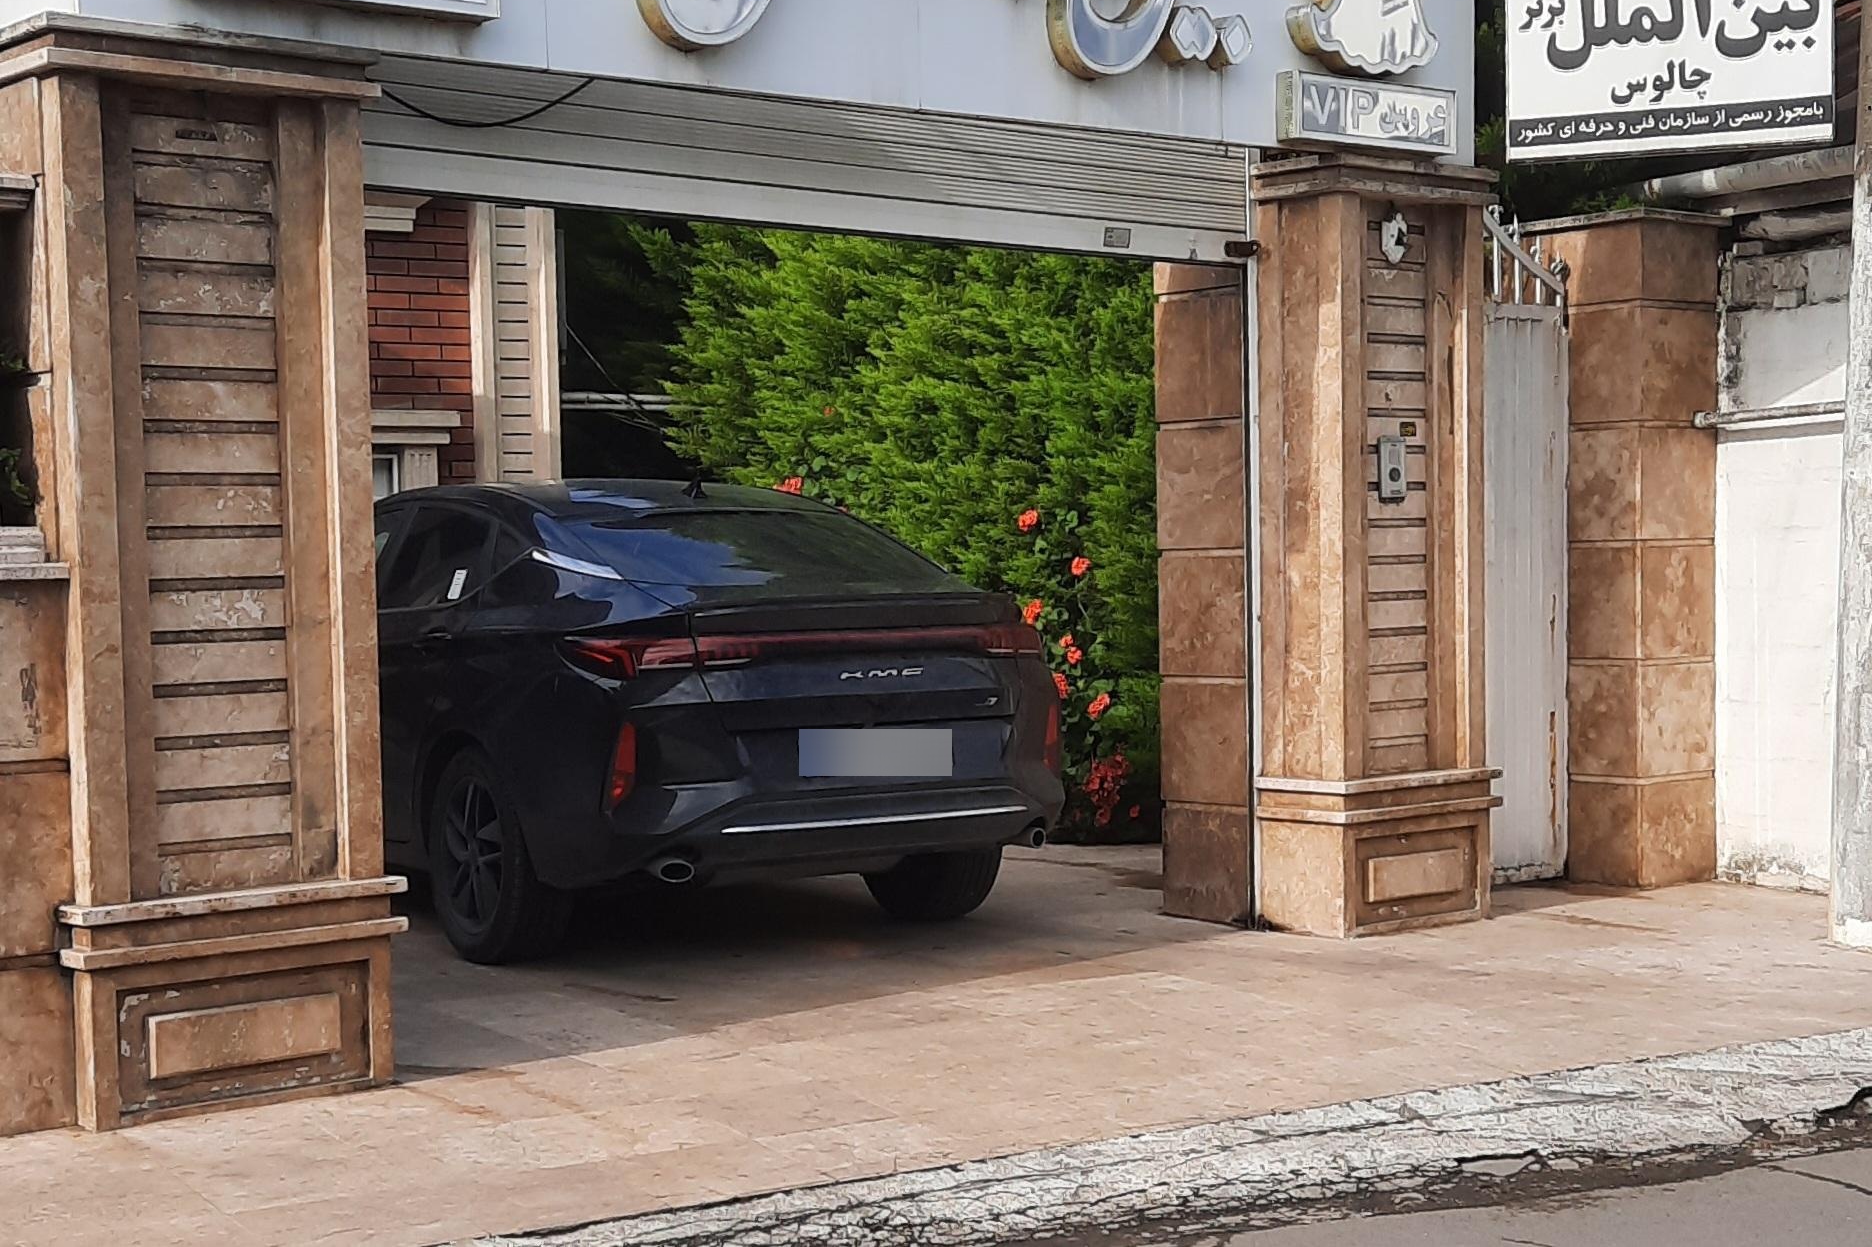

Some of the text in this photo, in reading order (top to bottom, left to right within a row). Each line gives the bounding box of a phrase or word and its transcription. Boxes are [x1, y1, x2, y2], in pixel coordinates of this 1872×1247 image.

[1610, 58, 1712, 104] چالوس
[1309, 82, 1376, 130] VIP
[1578, 117, 1614, 137] حرفه
[1617, 119, 1626, 135] و
[1630, 114, 1656, 134] فنی
[1658, 111, 1710, 131] سازمان
[1713, 108, 1726, 127] از
[1728, 109, 1772, 127] رسمی
[1517, 122, 1556, 143] کشور
[839, 666, 925, 680] KMC
